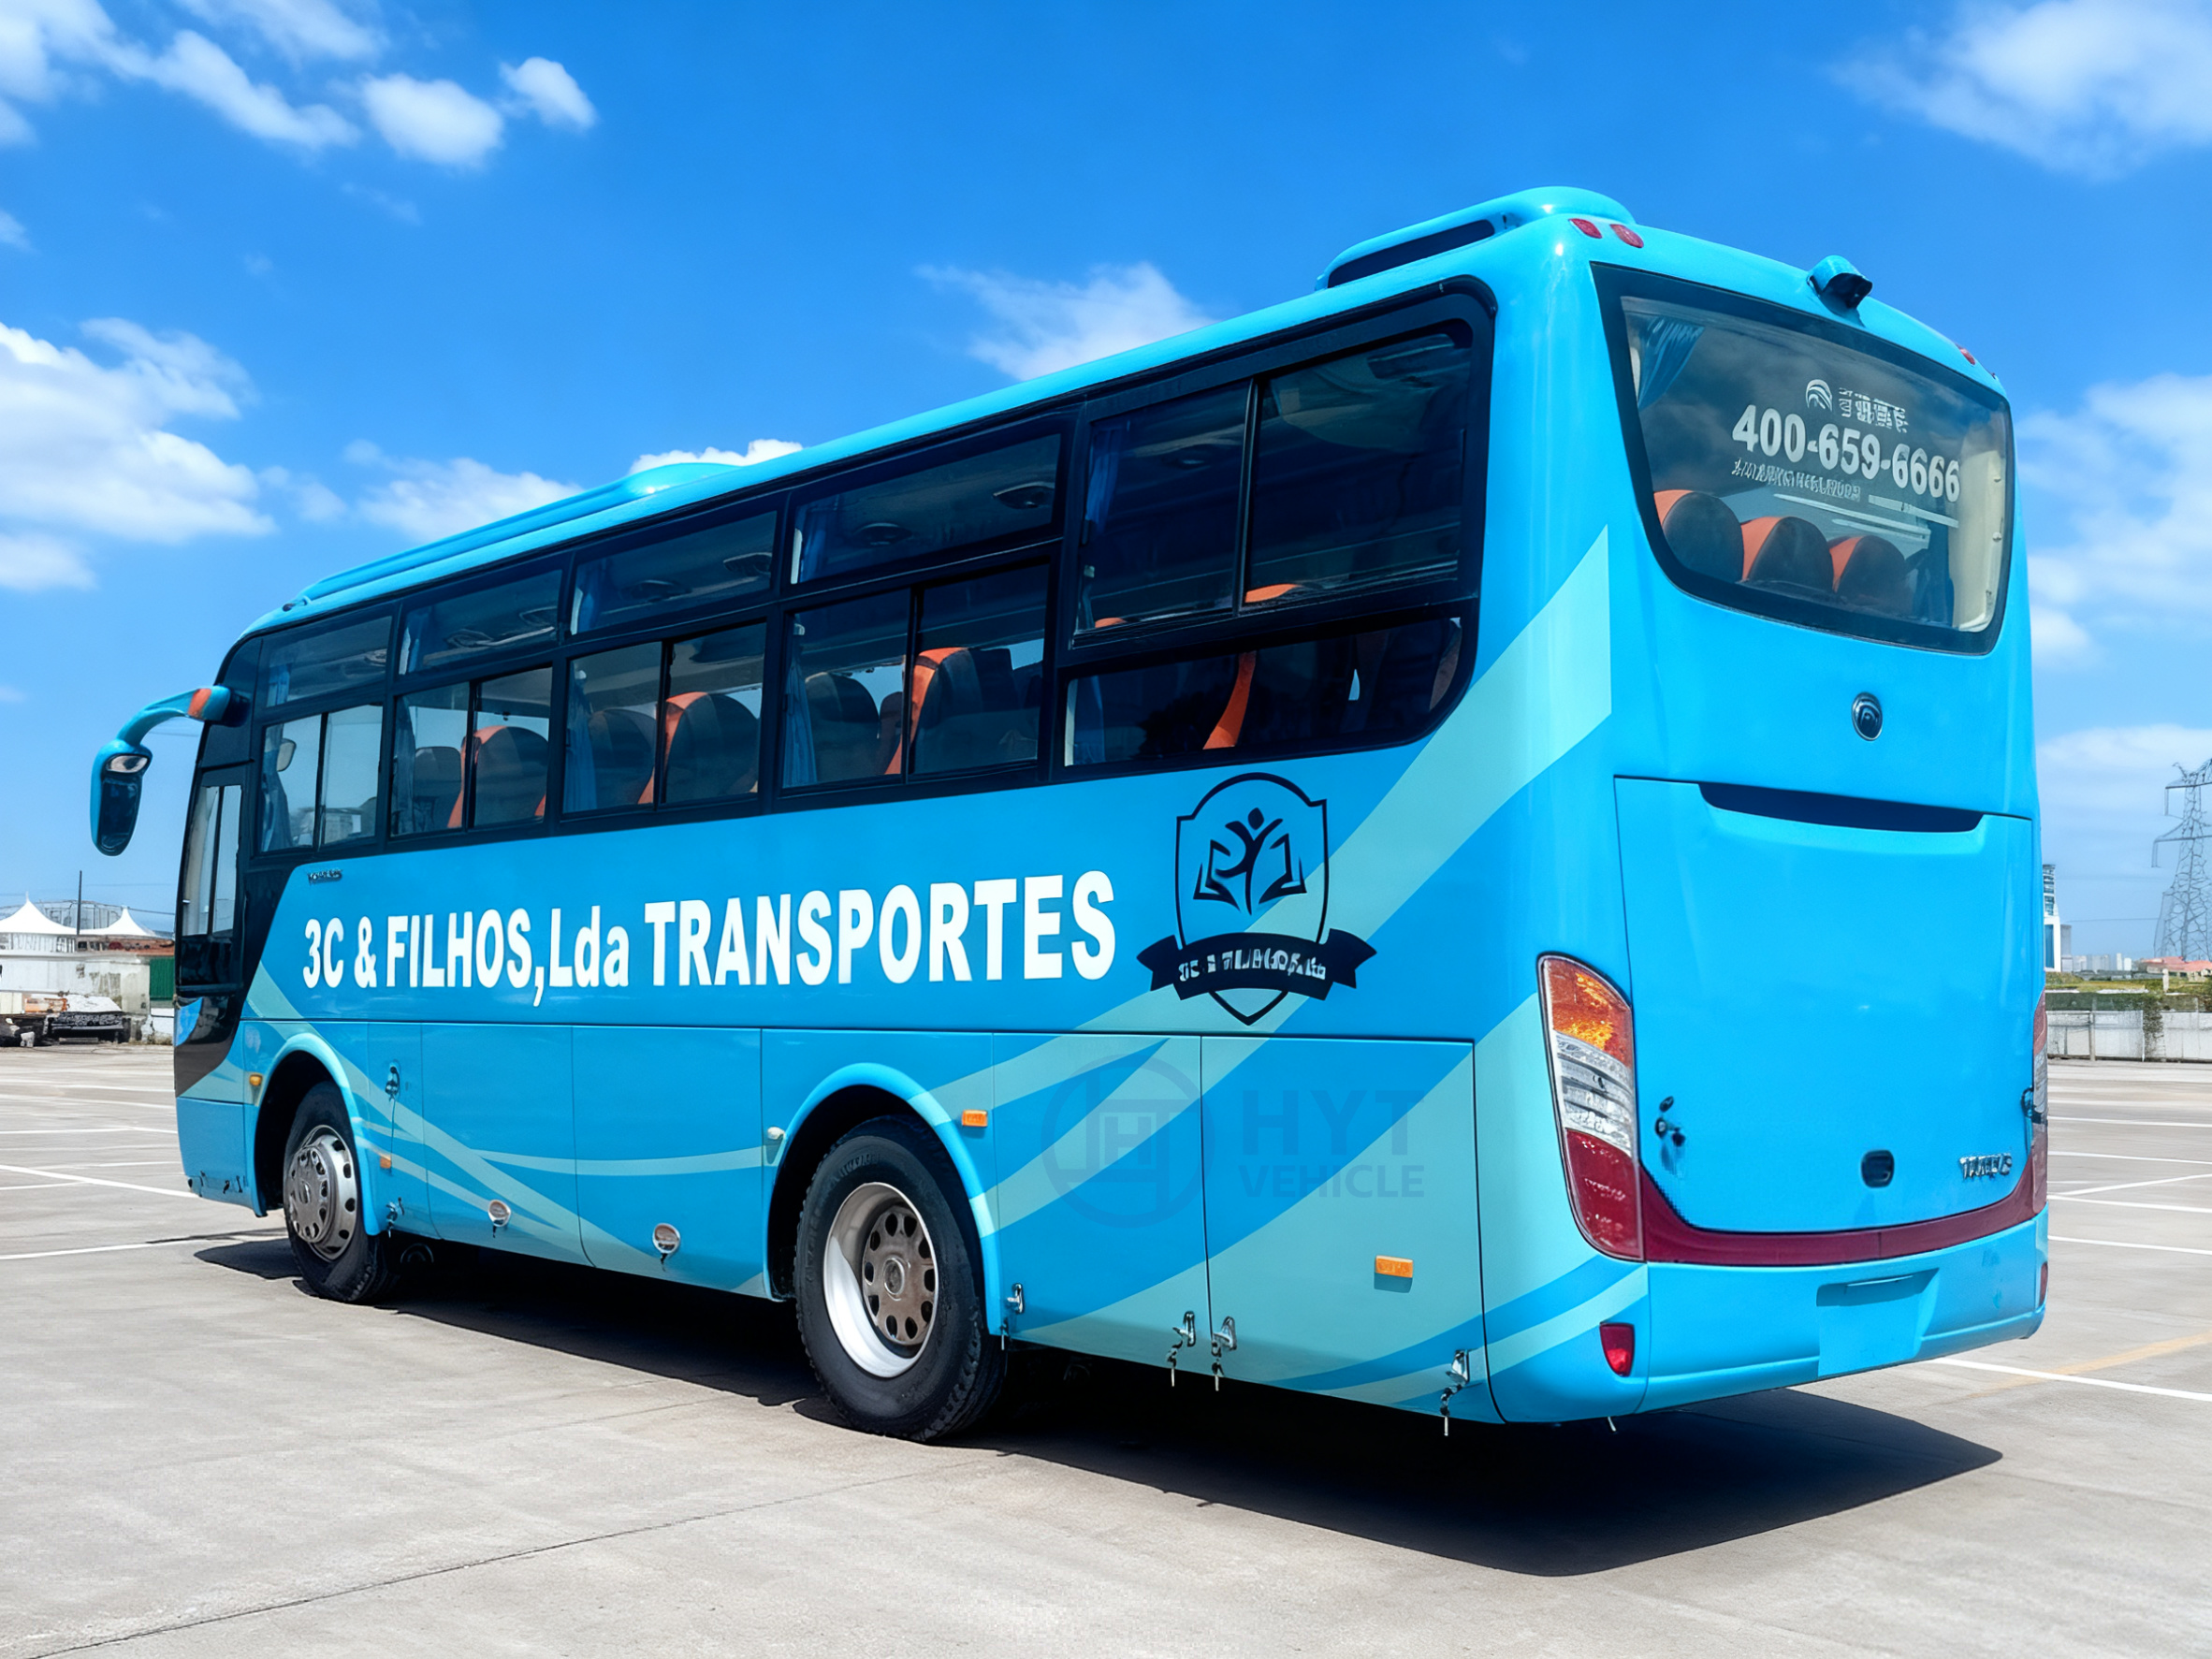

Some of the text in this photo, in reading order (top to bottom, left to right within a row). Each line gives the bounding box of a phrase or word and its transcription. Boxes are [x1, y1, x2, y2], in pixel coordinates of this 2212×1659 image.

[1732, 404, 1960, 502] 400-659-6666
[302, 918, 344, 988] 3C
[354, 916, 377, 988] &
[644, 870, 1115, 986] TRANSPORTES
